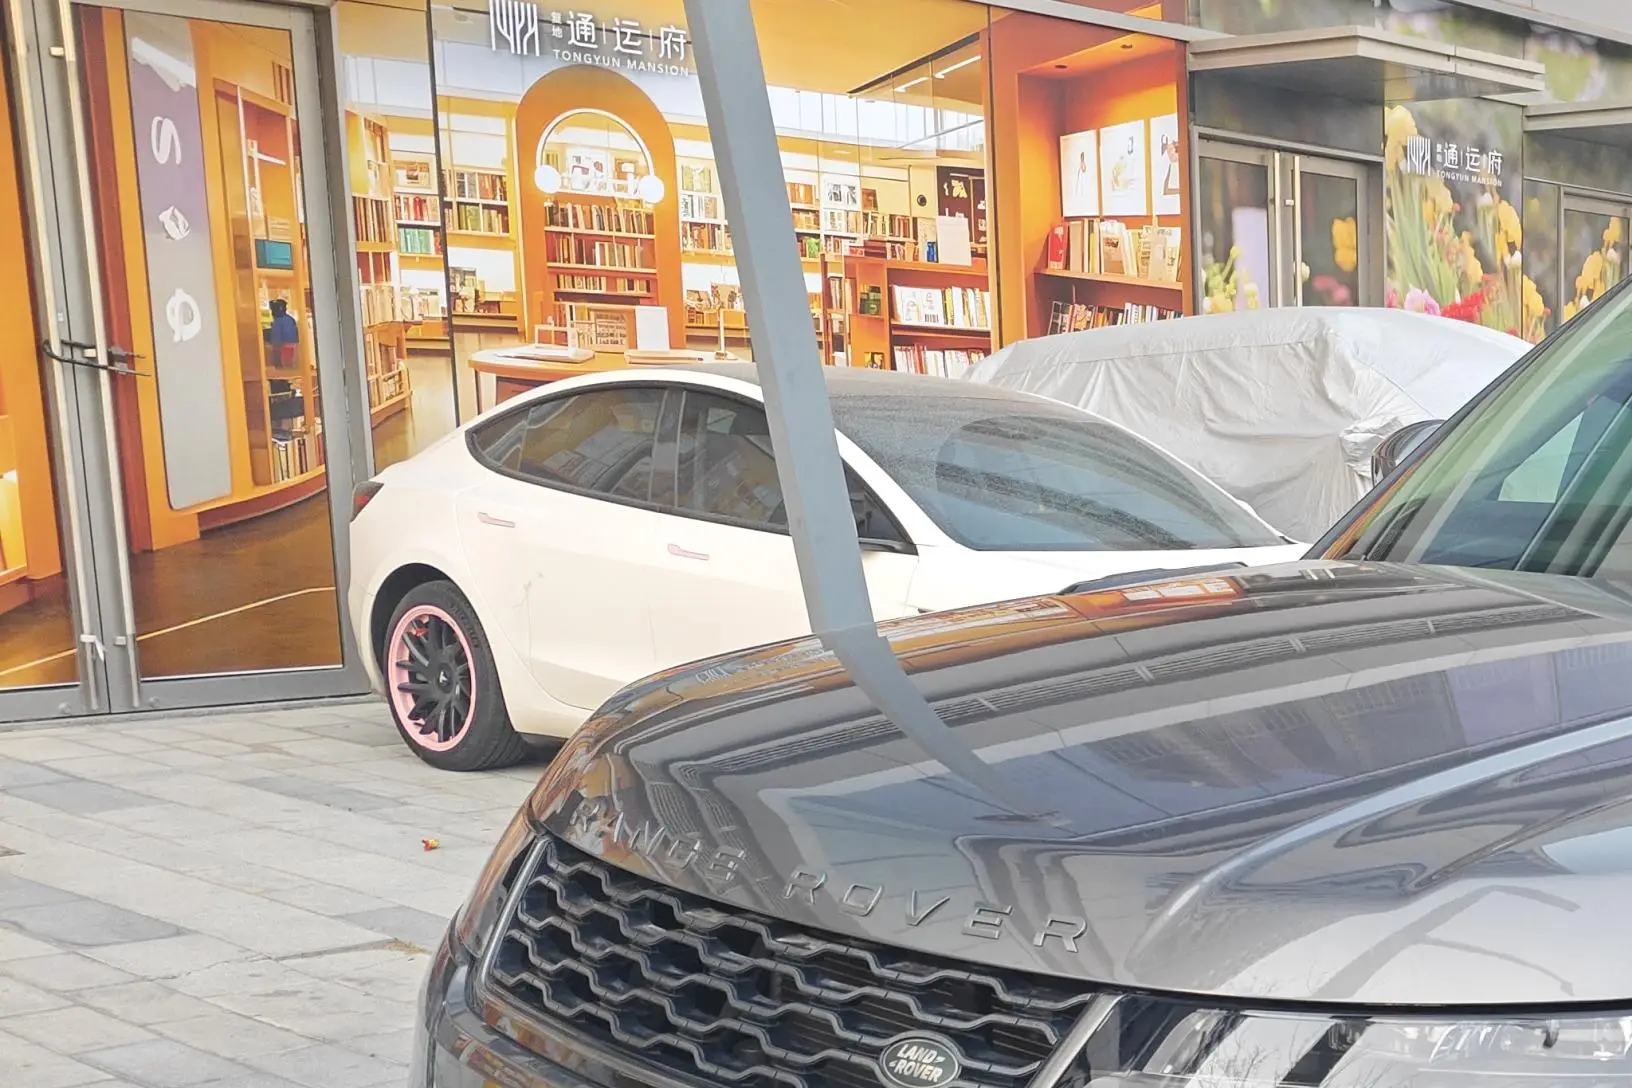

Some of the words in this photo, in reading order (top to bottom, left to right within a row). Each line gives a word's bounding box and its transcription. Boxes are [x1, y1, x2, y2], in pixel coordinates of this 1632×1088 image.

[553, 49, 621, 68] TONGYUN
[627, 59, 689, 77] MANSION
[1436, 170, 1470, 182] TONGYUN
[1471, 175, 1502, 187] MANSION
[569, 803, 748, 882] RANGE
[784, 868, 1088, 953] ROVER
[897, 1043, 938, 1064] LAND
[893, 1059, 943, 1083] ROVER
